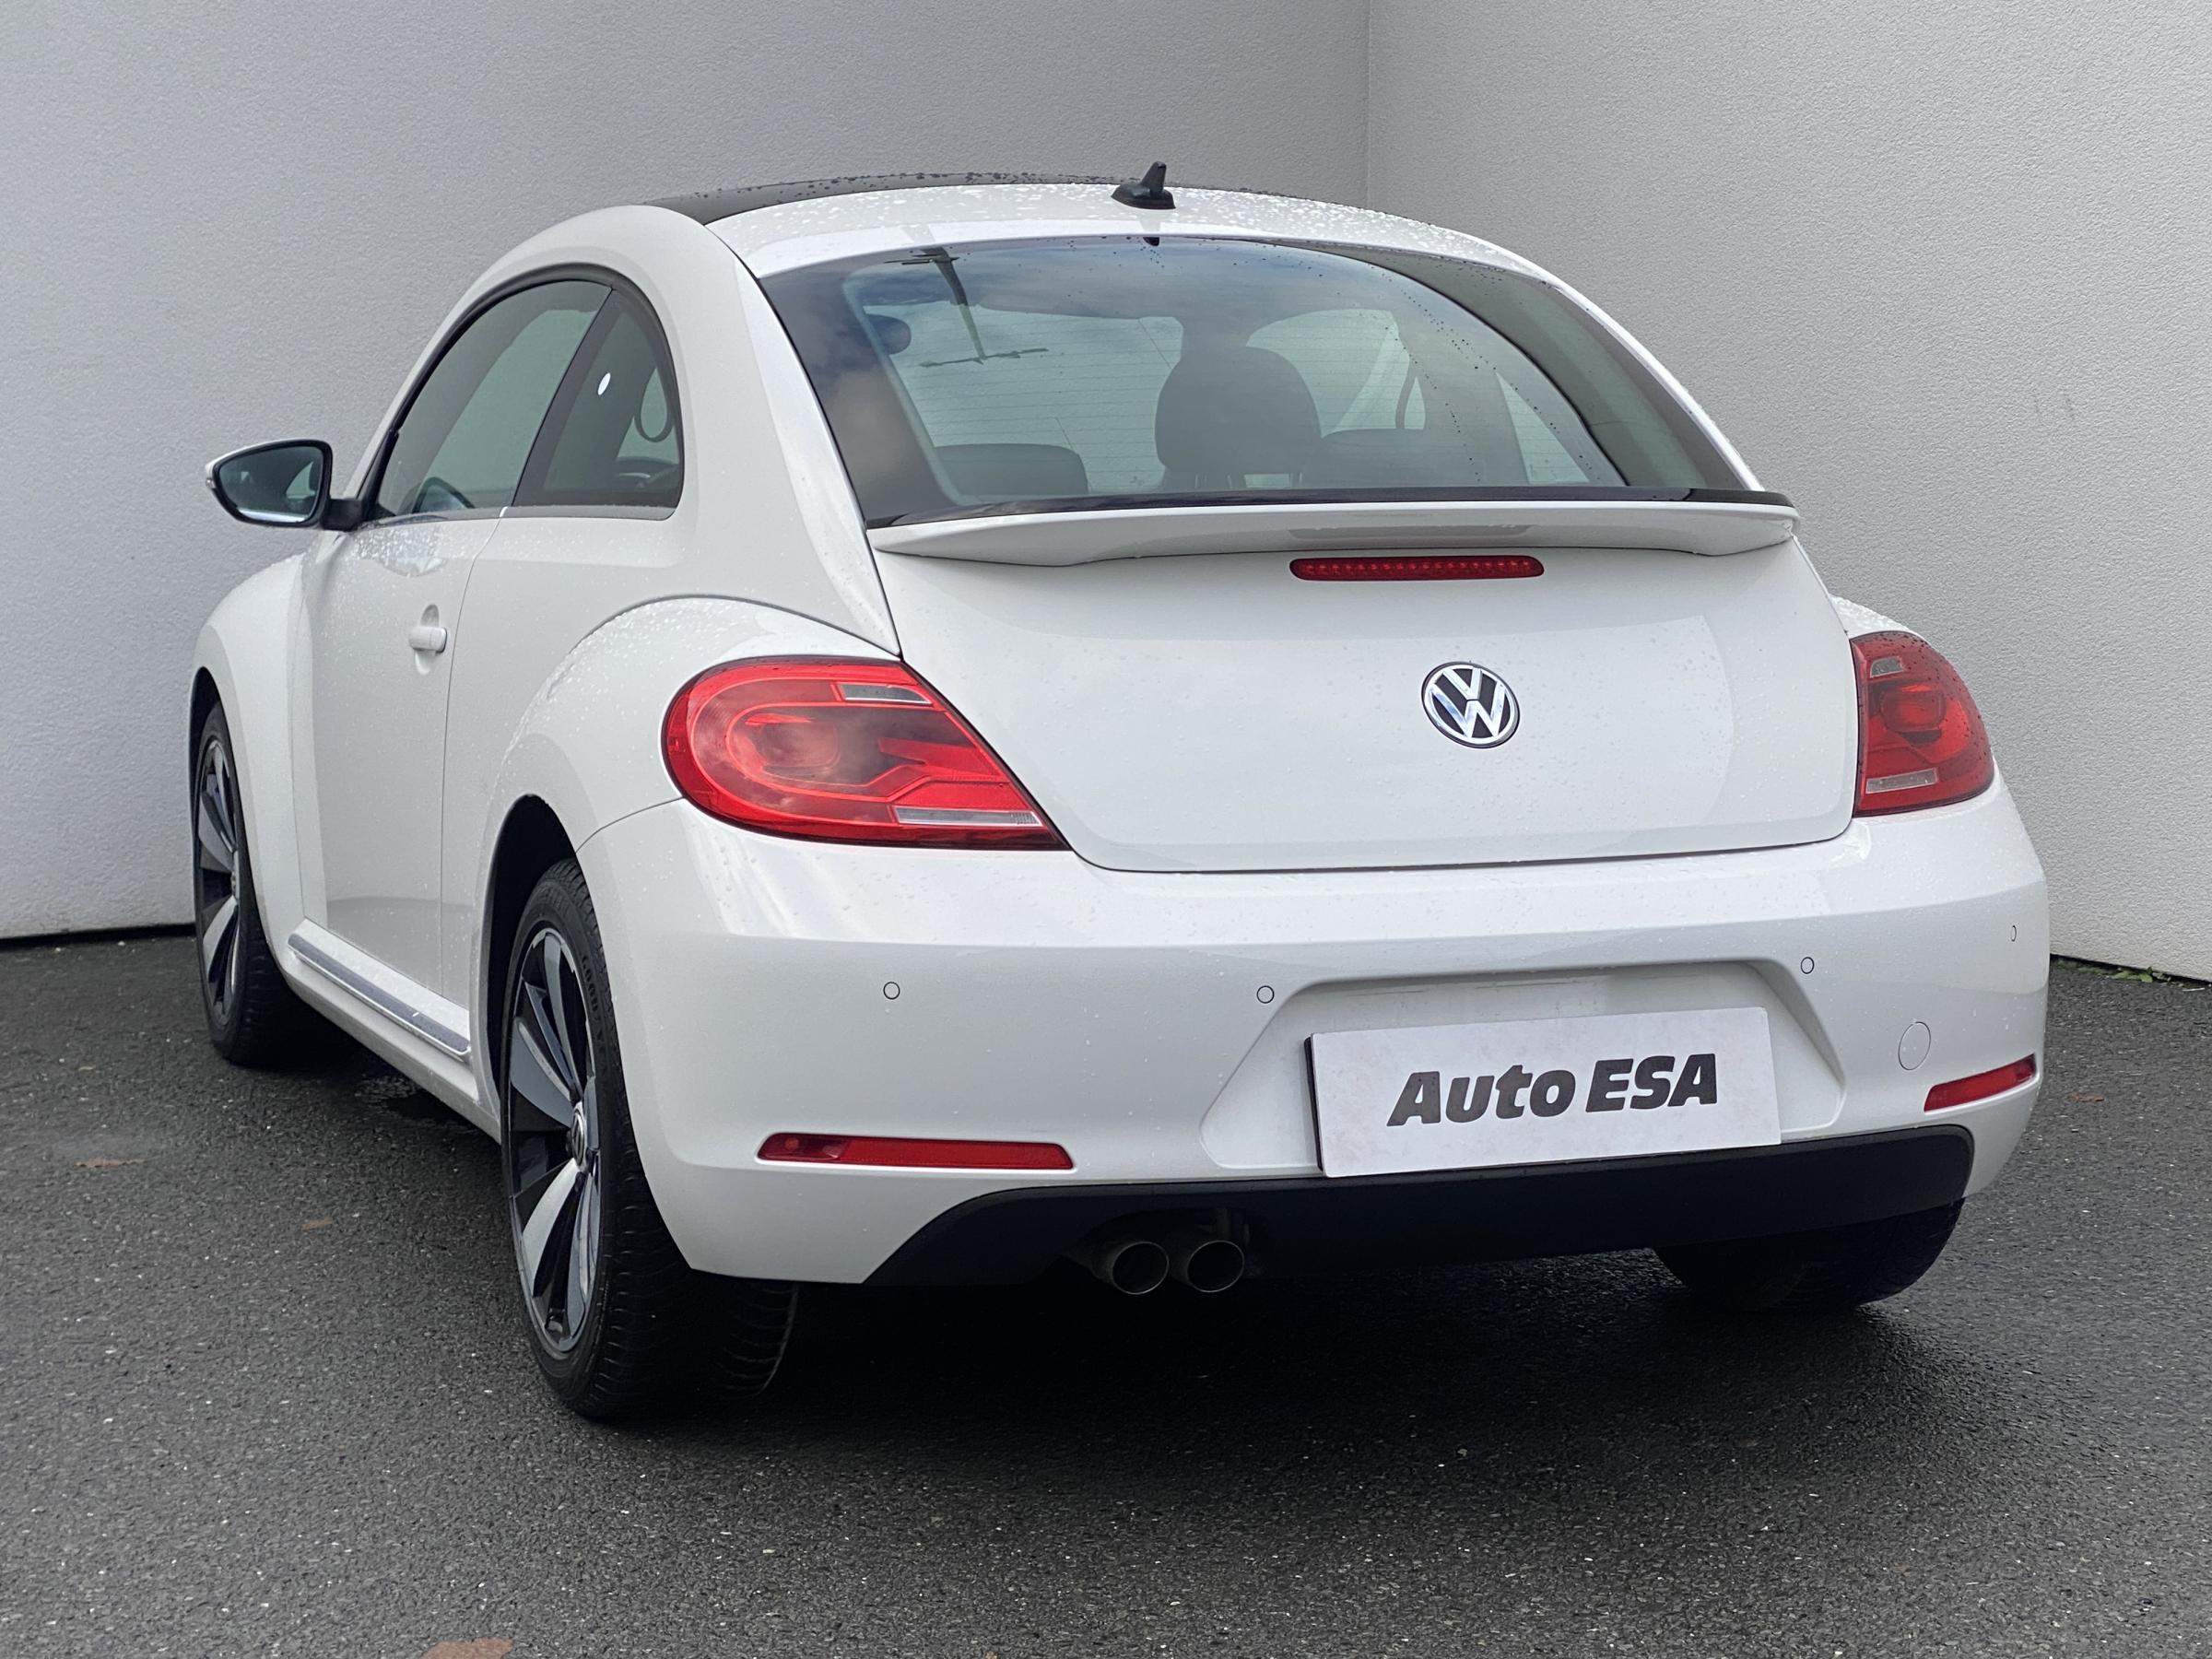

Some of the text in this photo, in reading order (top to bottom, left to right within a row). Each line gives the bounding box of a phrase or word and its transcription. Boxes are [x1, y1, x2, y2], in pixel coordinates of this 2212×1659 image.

[1426, 665, 1513, 744] VW
[1386, 1053, 1718, 1127] Auto ESA
